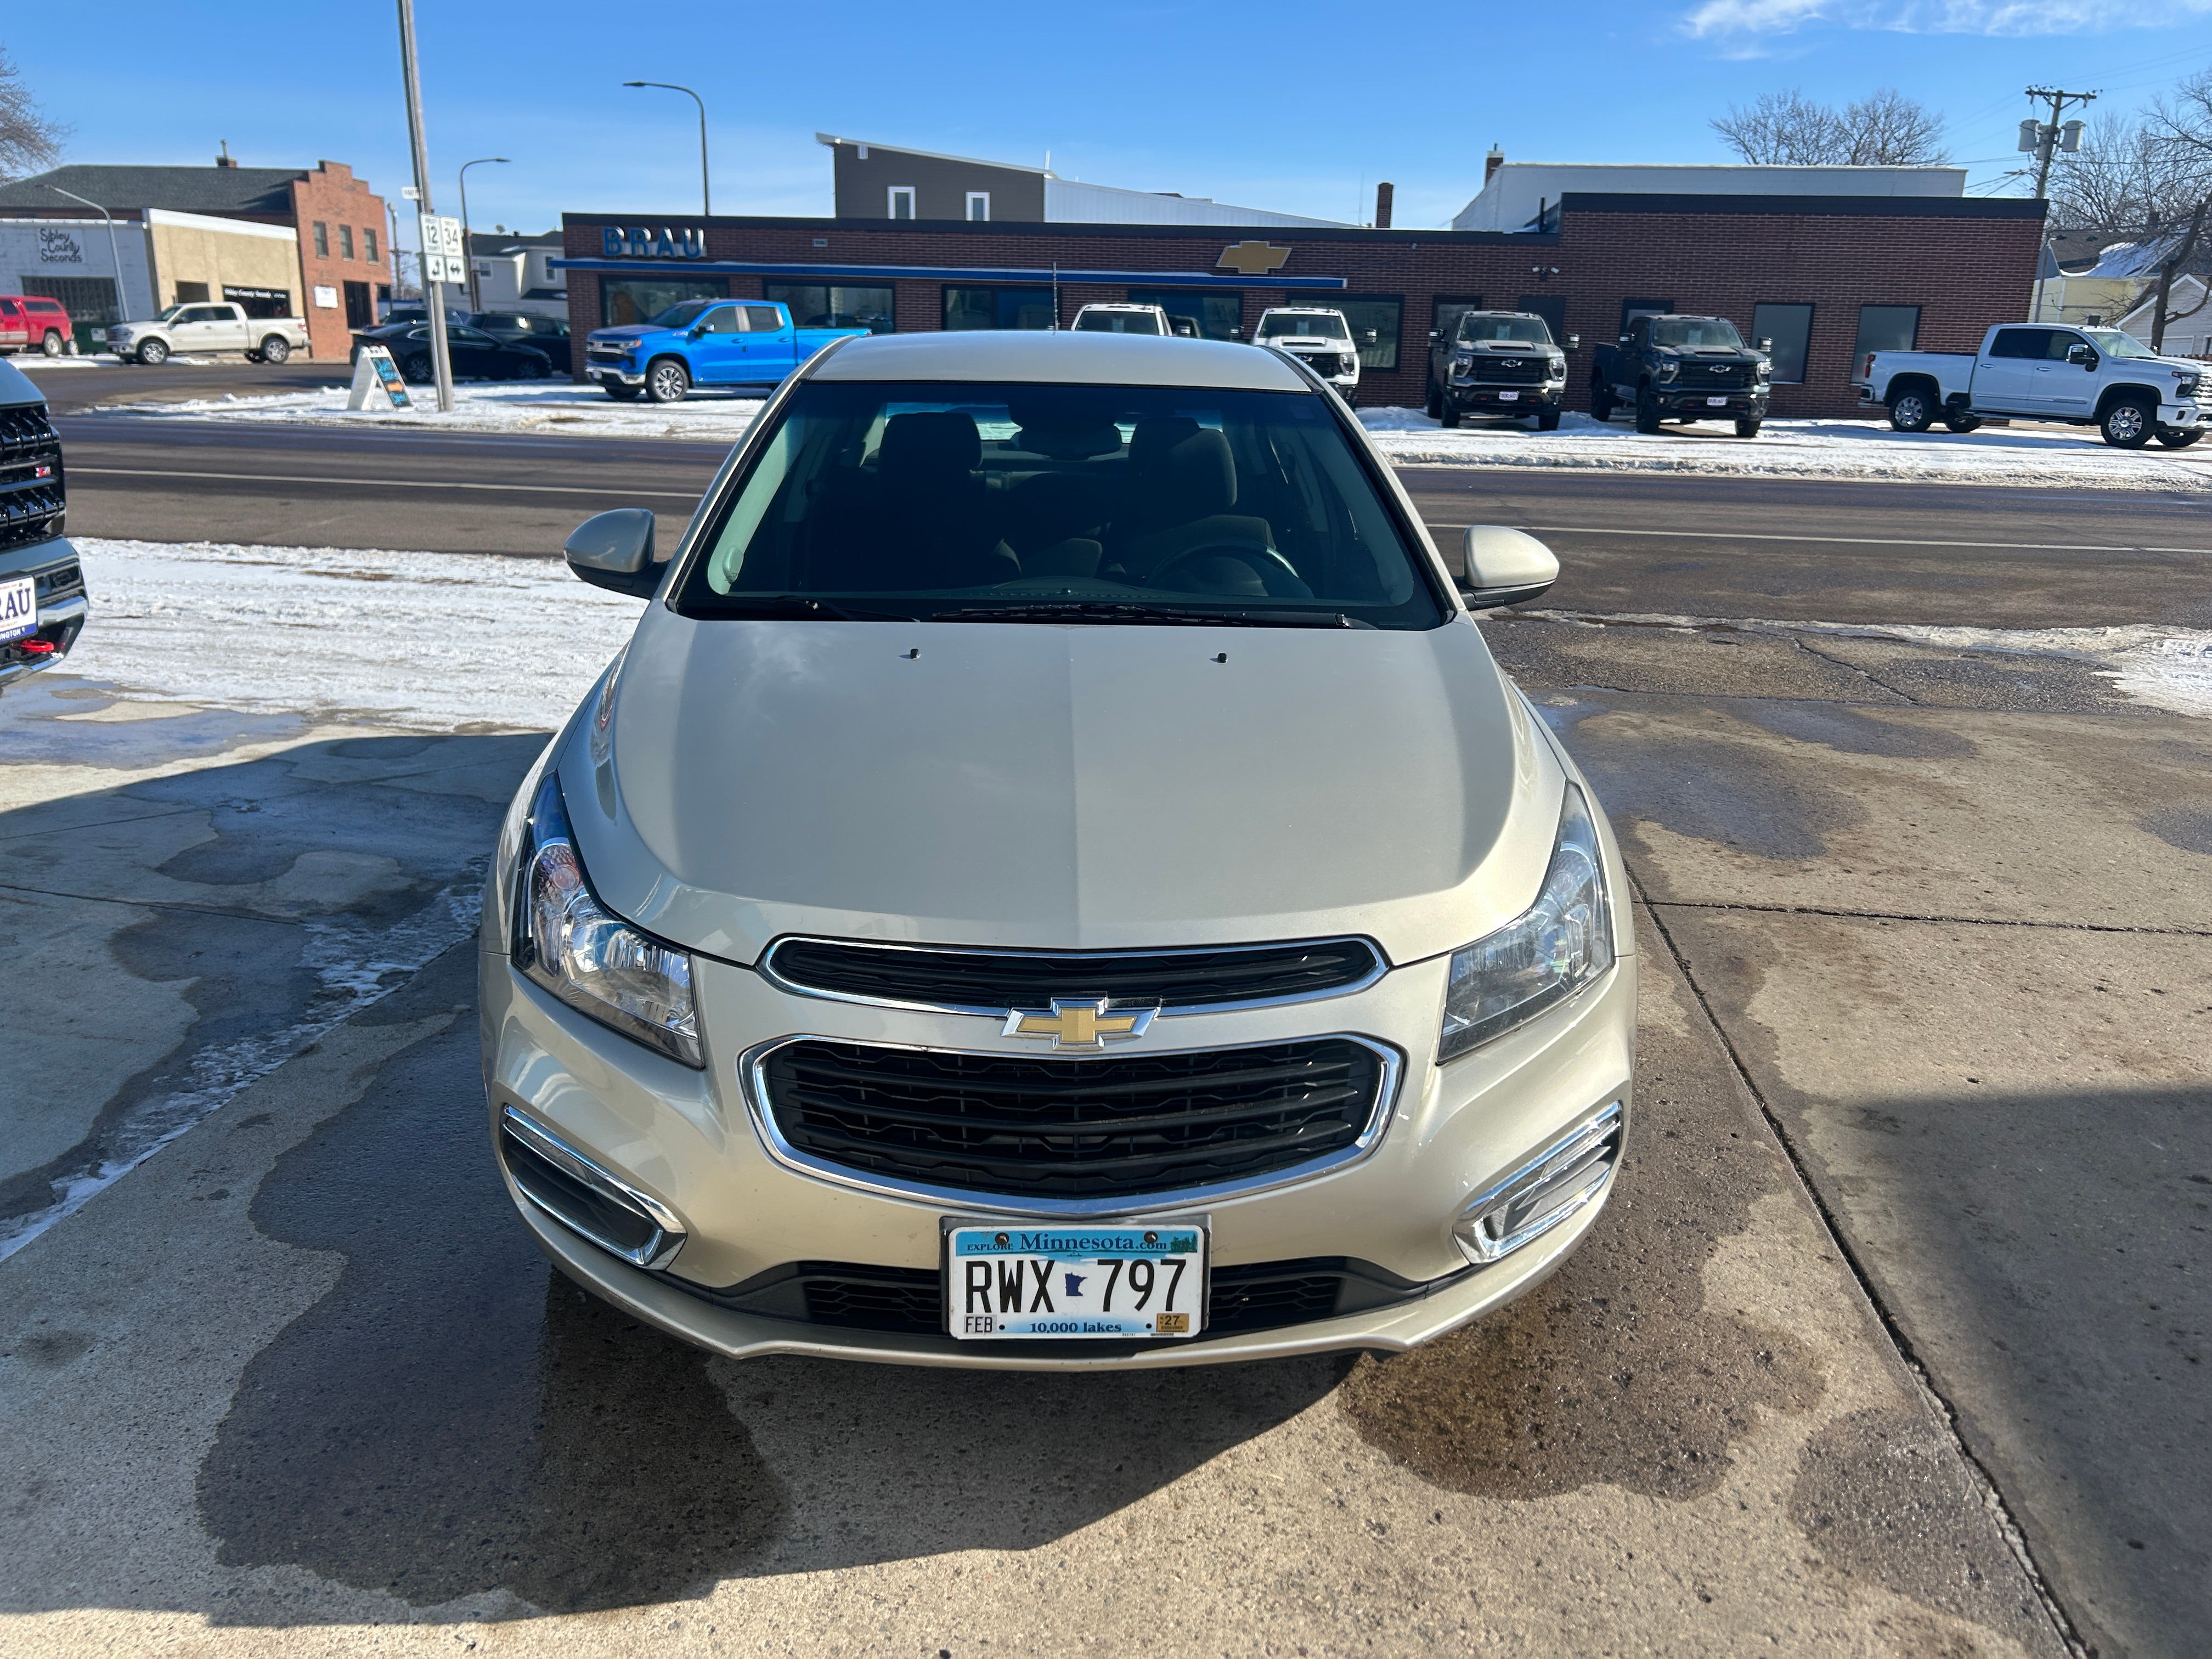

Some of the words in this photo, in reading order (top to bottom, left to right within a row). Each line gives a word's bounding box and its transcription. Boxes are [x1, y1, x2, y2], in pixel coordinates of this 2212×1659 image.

[40, 228, 70, 242] Sibley
[426, 225, 438, 244] 12
[444, 228, 458, 245] 34
[604, 226, 704, 259] BRAU
[41, 248, 82, 263] Seconds
[48, 239, 80, 256] County
[0, 586, 31, 620] AU
[1019, 1233, 1167, 1250] Minnesota.com
[966, 1260, 1055, 1313] RWX
[1097, 1259, 1186, 1312] 797
[966, 1317, 992, 1333] FEB
[1030, 1323, 1078, 1333] 10,000
[1083, 1322, 1121, 1333] lakes
[1165, 1315, 1180, 1325] 27
